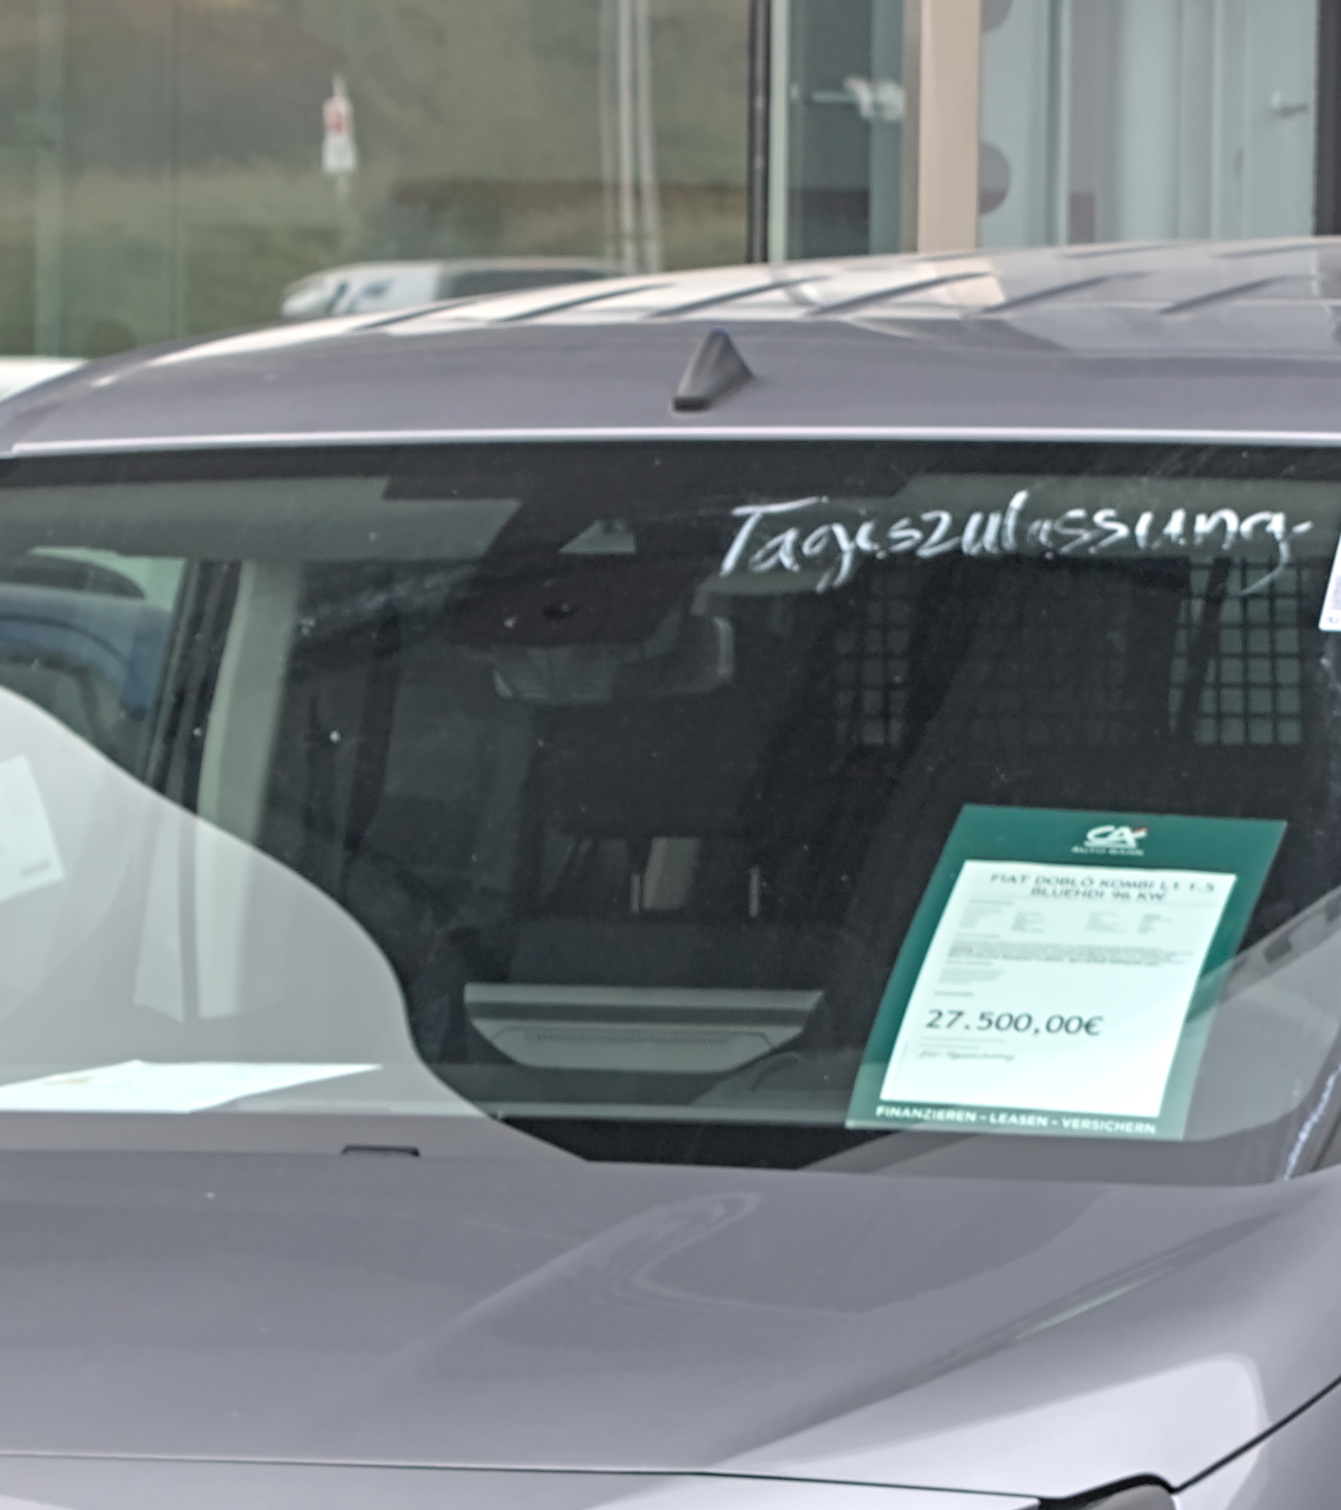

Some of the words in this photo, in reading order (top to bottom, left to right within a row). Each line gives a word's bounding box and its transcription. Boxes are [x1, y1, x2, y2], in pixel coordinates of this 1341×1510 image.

[990, 873, 1029, 885] FIAT
[1099, 878, 1154, 891] KOMBI
[1137, 890, 1167, 902] KW
[925, 1008, 1104, 1036] 27.500,00€
[875, 1105, 977, 1123] FINANZIEREN
[989, 1109, 1048, 1127] LEASEN
[1061, 1117, 1157, 1135] VERSICHERN
